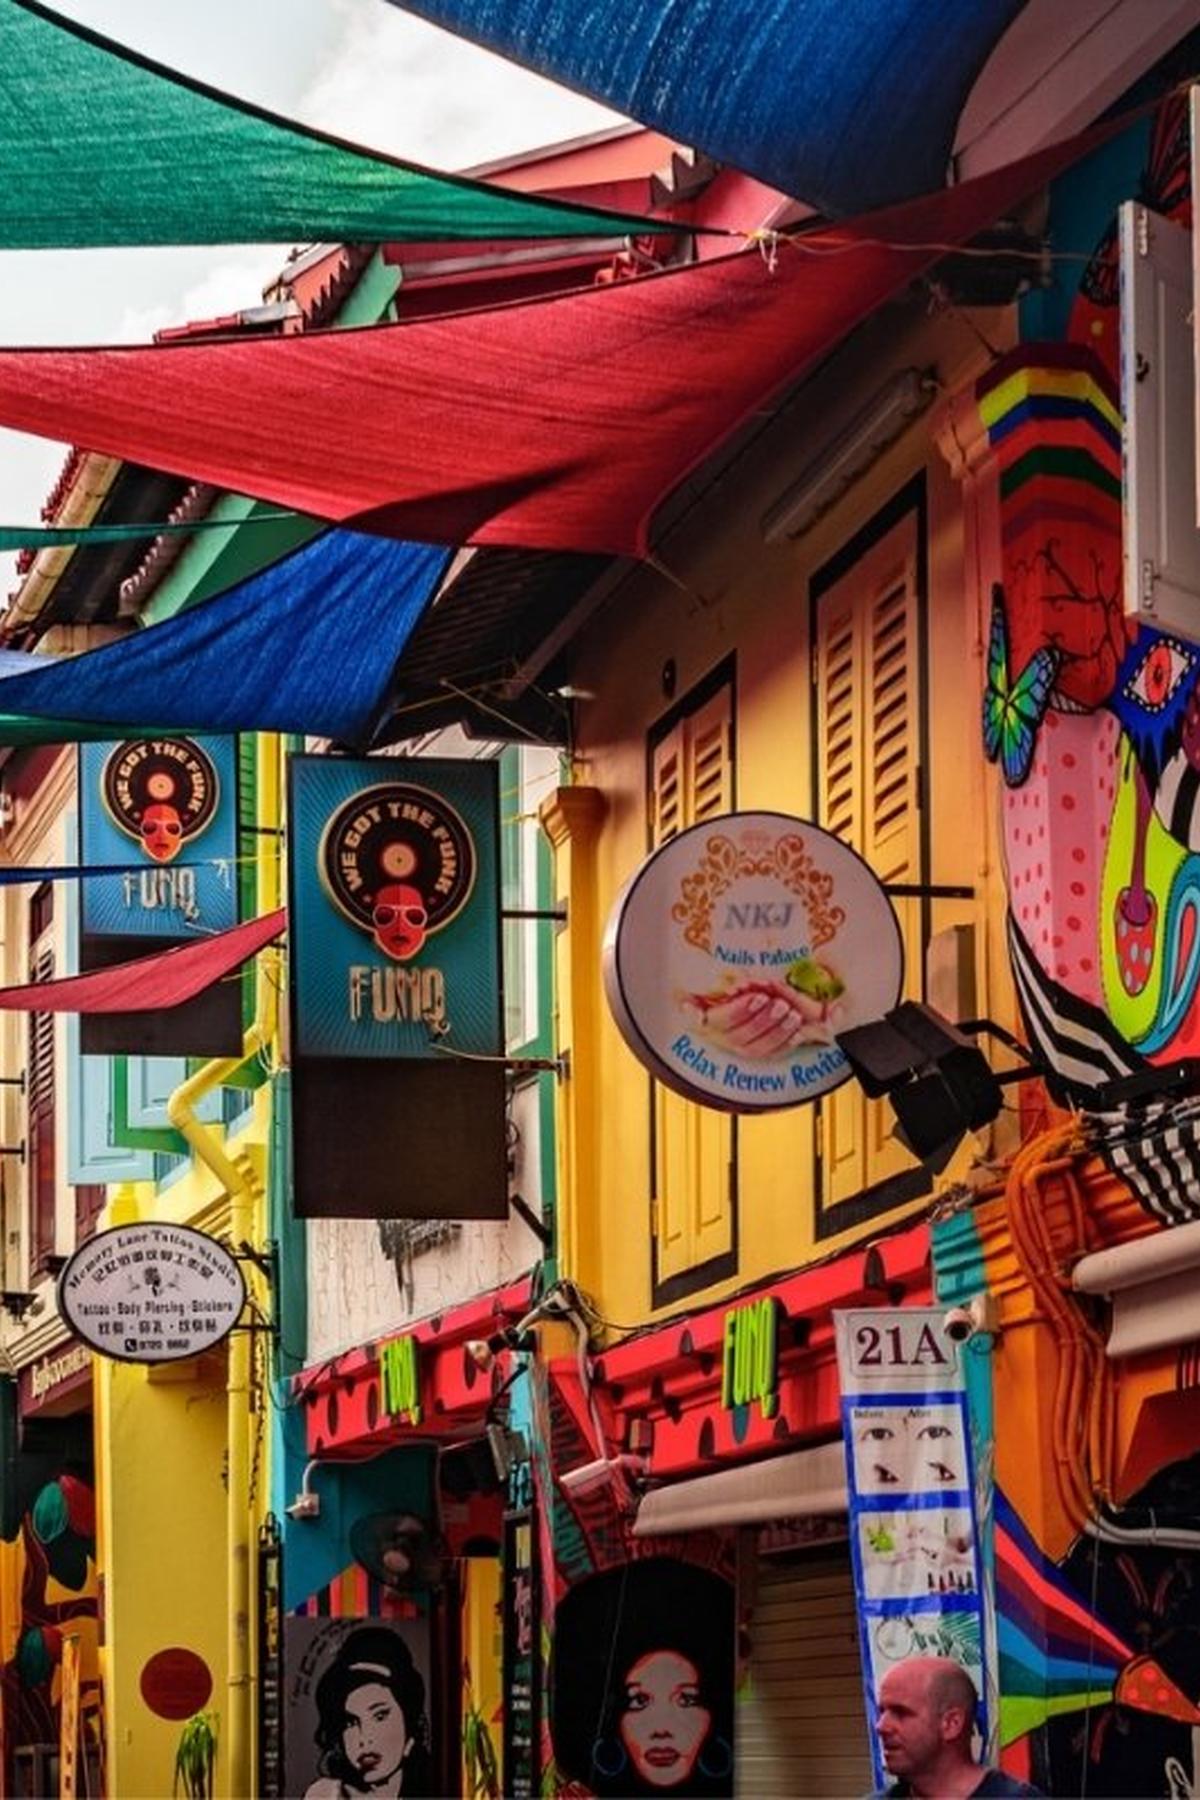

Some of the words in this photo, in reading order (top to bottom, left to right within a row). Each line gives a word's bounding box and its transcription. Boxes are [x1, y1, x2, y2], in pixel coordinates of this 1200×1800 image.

[119, 746, 149, 778] GOT
[151, 742, 190, 764] THE
[116, 780, 133, 811] WE
[186, 760, 206, 812] FUNK
[344, 806, 382, 848] GOT
[388, 802, 435, 829] THE
[341, 852, 363, 891] WE
[432, 826, 457, 894] FUNK
[725, 903, 794, 930] NKJ
[714, 944, 755, 965] Nails
[760, 946, 810, 966] Palace
[672, 1034, 718, 1080] Relax
[724, 1064, 786, 1092] Renew
[790, 1048, 850, 1087] Revita
[151, 1229, 194, 1250] Tattoo
[856, 1323, 948, 1366] 21A
